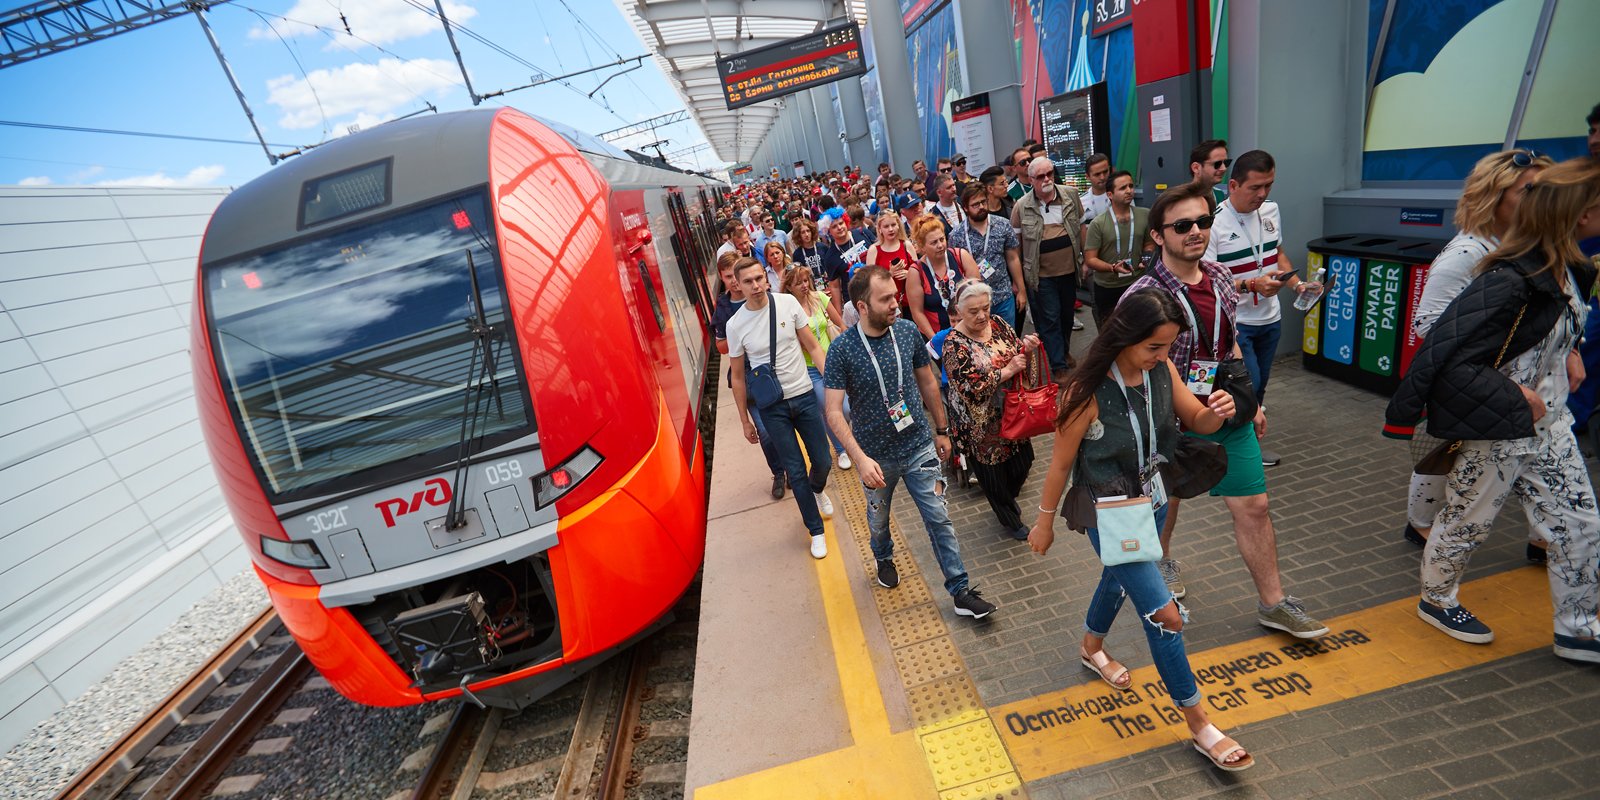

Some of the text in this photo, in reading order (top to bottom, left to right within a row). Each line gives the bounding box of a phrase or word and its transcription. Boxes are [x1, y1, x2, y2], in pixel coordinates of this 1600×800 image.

[727, 61, 736, 74] 2
[768, 62, 816, 79] Гагарина
[1328, 259, 1342, 331] СТЕКЛО
[1342, 262, 1357, 320] GLASS
[1364, 264, 1384, 341] БУМАГА
[1381, 267, 1400, 330] PAPER
[485, 459, 523, 485] 059
[1005, 629, 1371, 736] Остановка поеднего вагона
[1101, 713, 1156, 739] The
[1207, 687, 1248, 711] car
[1251, 672, 1312, 699] stop
